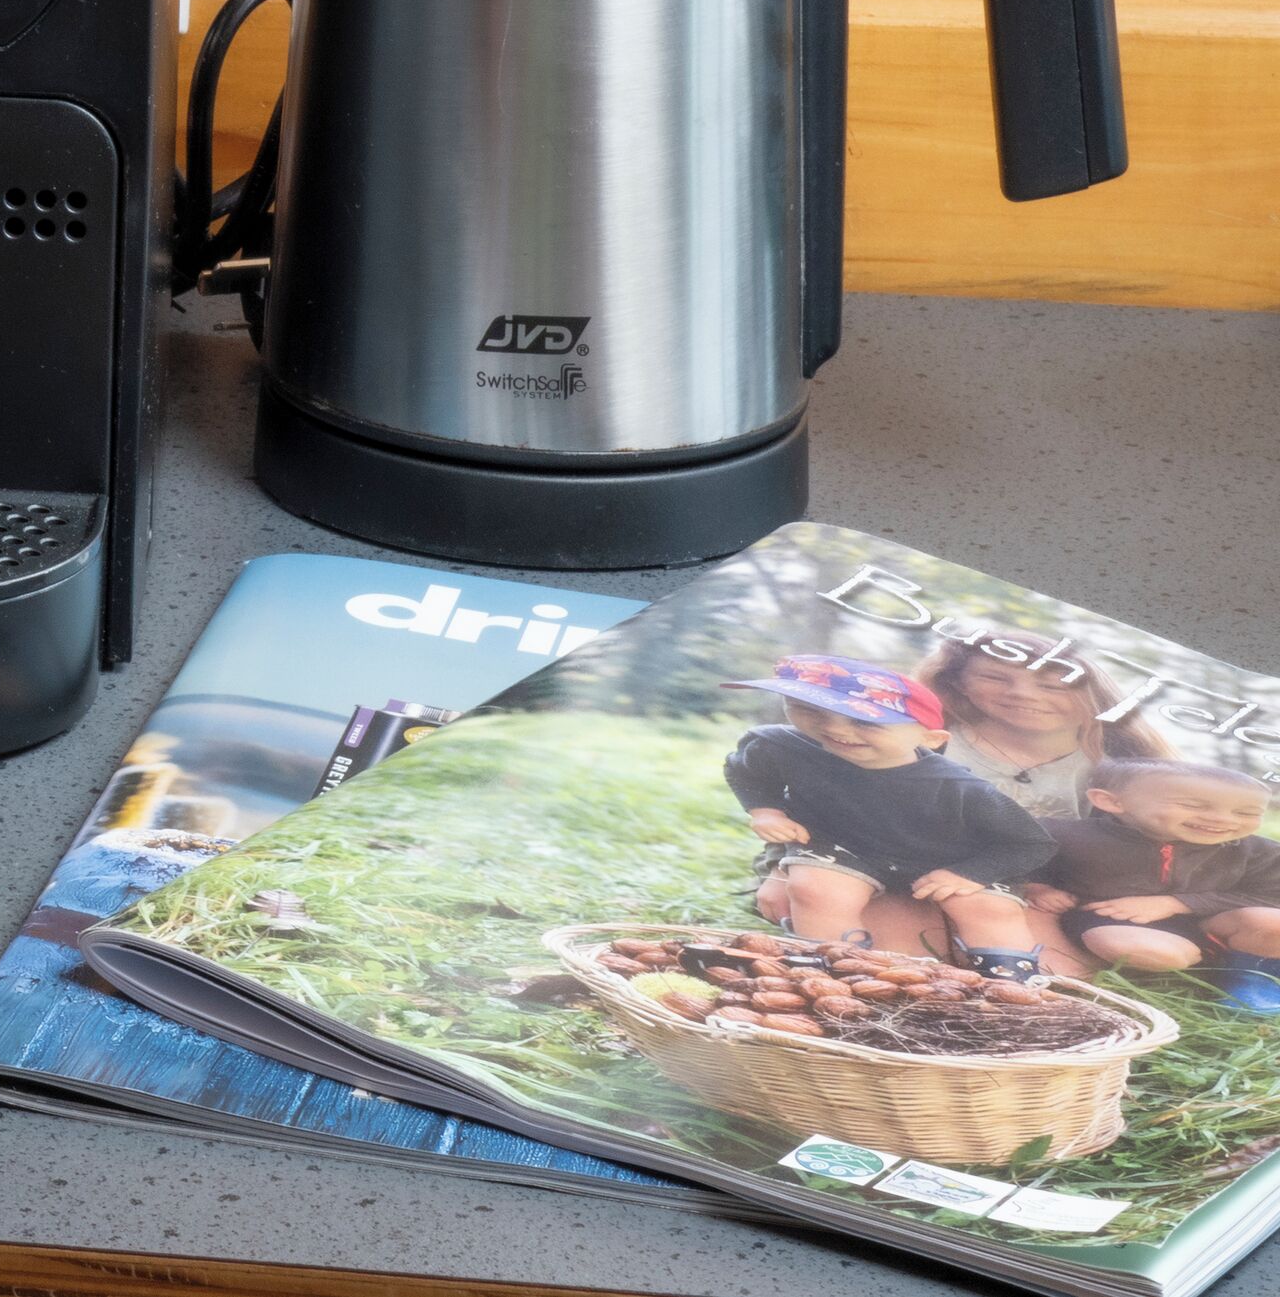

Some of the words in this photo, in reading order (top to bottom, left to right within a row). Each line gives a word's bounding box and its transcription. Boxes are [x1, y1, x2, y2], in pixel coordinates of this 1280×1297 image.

[485, 314, 572, 351] JVD
[513, 390, 561, 400] SYSTEM
[816, 563, 1086, 684] Bush
[320, 755, 353, 796] GREY
